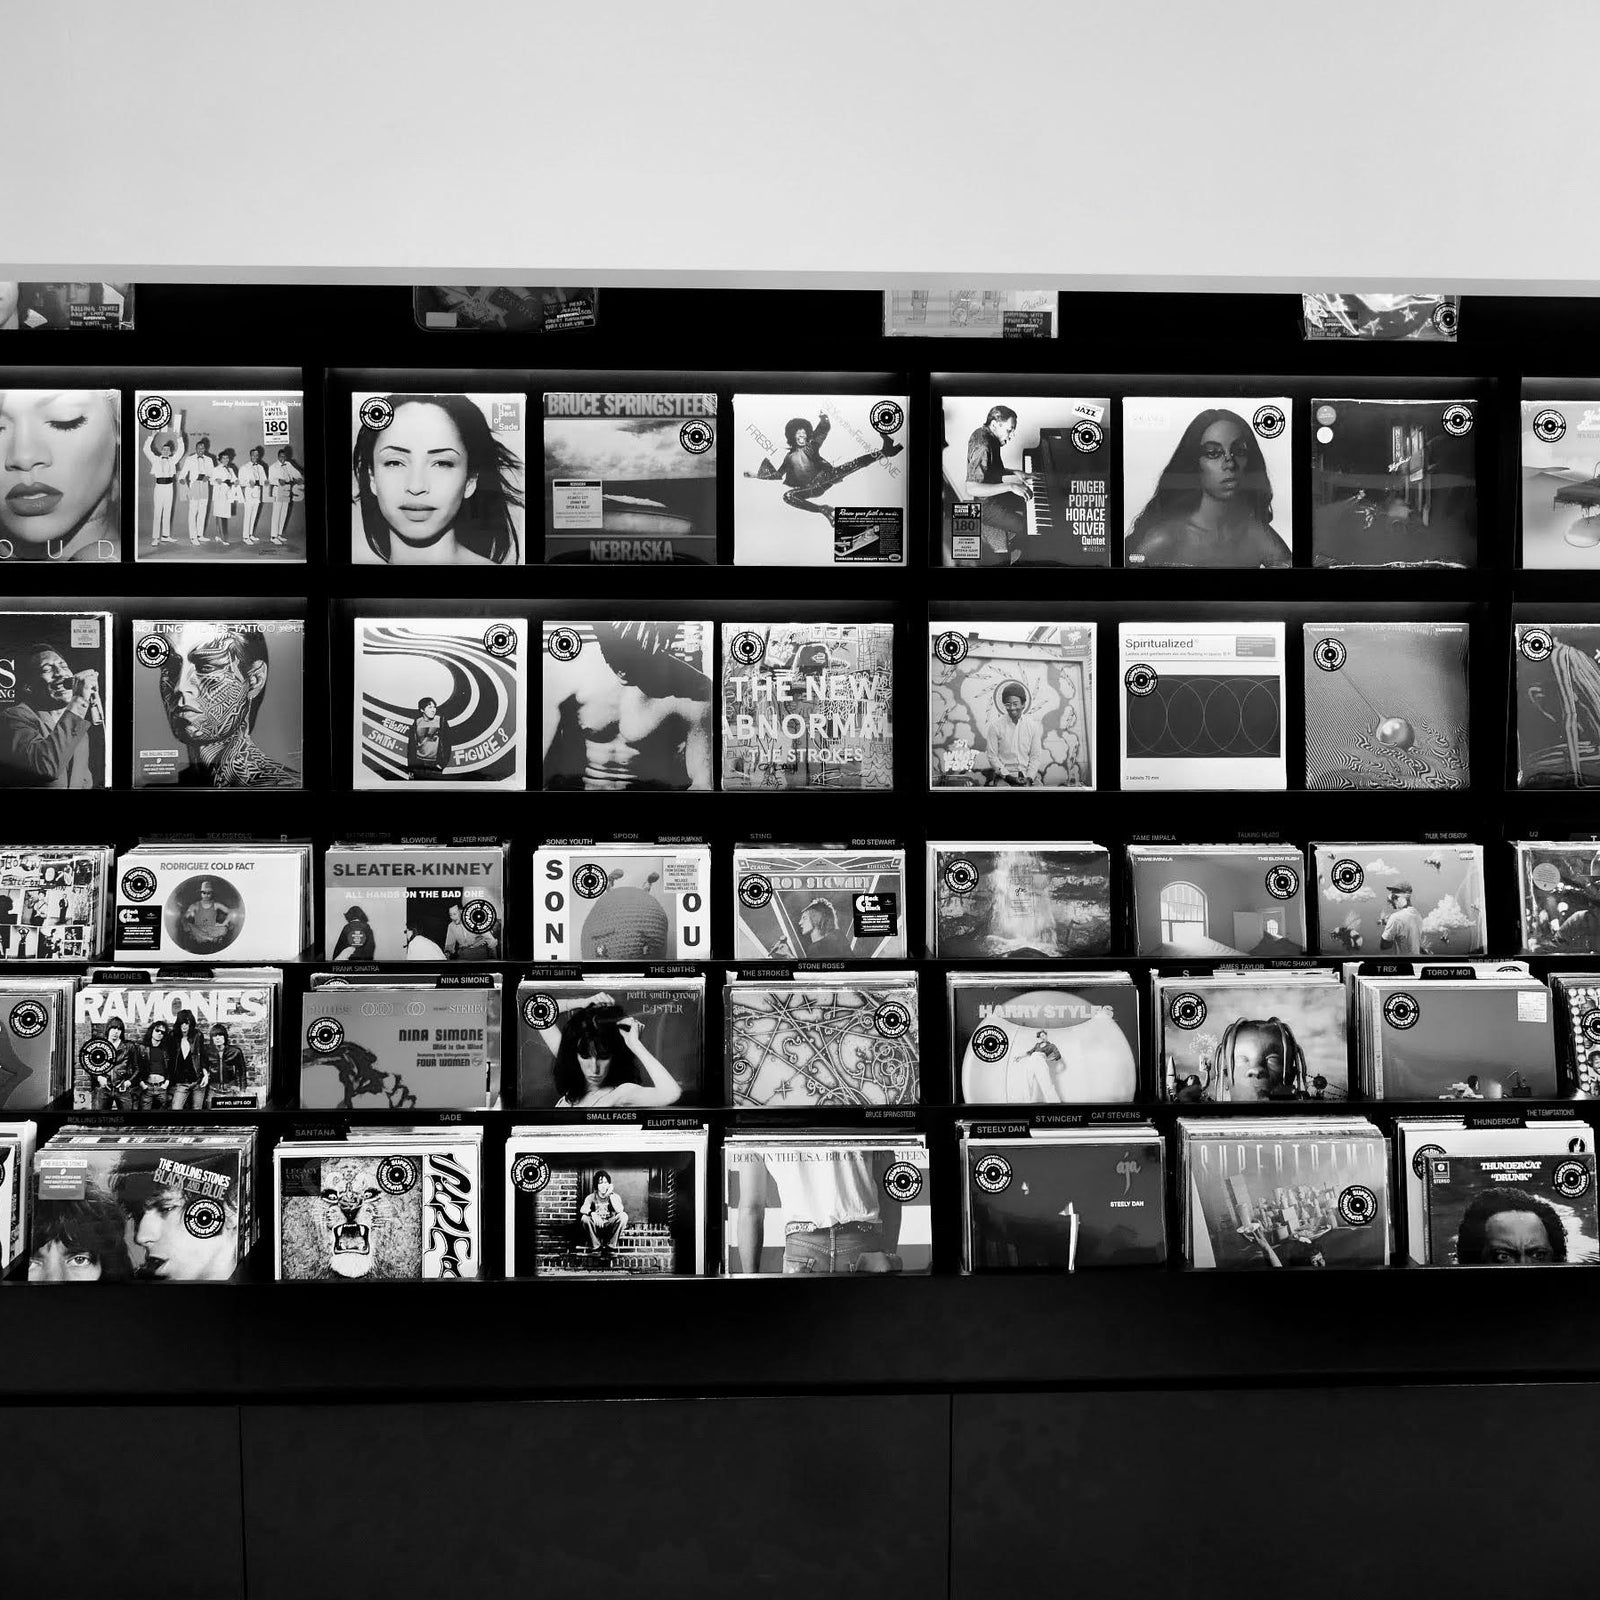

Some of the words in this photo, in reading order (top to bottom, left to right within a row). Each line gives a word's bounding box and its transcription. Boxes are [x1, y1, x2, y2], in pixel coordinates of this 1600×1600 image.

[548, 393, 600, 415] BRUCE
[603, 393, 716, 416] SPRINGSTEEN
[1074, 406, 1097, 418] JAZZ
[264, 420, 288, 432] 180
[498, 423, 519, 431] Sade
[745, 423, 779, 457] FRESH
[1071, 480, 1105, 494] FINGER
[1068, 494, 1108, 508] POPPIN'
[1065, 508, 1106, 522] HORACE
[953, 520, 976, 531] 180
[1072, 522, 1105, 536] SILVER
[1081, 536, 1106, 546] Quintet
[589, 540, 674, 562] NEBRASKA
[1125, 638, 1194, 651] Spiritualized
[730, 676, 794, 702] THE
[806, 675, 881, 701] NEW
[453, 735, 502, 765] FIGURE
[498, 728, 509, 742] 8
[750, 749, 783, 763] THE
[787, 748, 863, 763] STROKES
[658, 835, 680, 843] SMASHING
[681, 835, 703, 843] PUMPKINS
[867, 838, 896, 846] STEWART
[160, 862, 209, 871] RODRIGUEZ
[210, 862, 235, 871] COLD
[235, 862, 255, 871] FACT
[333, 862, 494, 877] SLEATER-KINNEY
[771, 877, 803, 889] ROD
[806, 876, 871, 889] STEWART
[403, 890, 418, 899] ON
[419, 890, 439, 899] THE
[441, 890, 462, 898] BAD
[463, 890, 485, 898] ONE
[544, 859, 565, 960] SON
[757, 969, 790, 977] STROKES
[1182, 969, 1190, 978] S
[1376, 965, 1382, 973] T
[1383, 965, 1398, 973] REX
[1427, 969, 1449, 977] TORO
[102, 972, 143, 980] RAMONES
[460, 976, 490, 984] SIMONE
[626, 991, 648, 1001] patti
[649, 990, 671, 999] smith
[672, 991, 699, 1002] group
[75, 990, 267, 1024] RAMONES
[978, 1004, 1040, 1019] HARRY
[1043, 1004, 1114, 1019] STYLES
[399, 1029, 429, 1042] NINA
[435, 1028, 484, 1041] SIMONE
[416, 1058, 437, 1067] FOUR
[439, 1058, 471, 1067] WOMEN
[439, 1113, 462, 1121] SADE
[612, 1112, 637, 1120] FACES
[882, 1110, 916, 1118] SPRINGSTEEN
[1107, 1111, 1141, 1119] STEVENS
[67, 1116, 97, 1124] ROLLING
[647, 1119, 675, 1127] ELLIOTT
[1472, 1118, 1521, 1126] THUNDERCAT
[295, 1129, 336, 1137] SANTANA
[976, 1126, 1007, 1134] STEELY
[1008, 1125, 1026, 1133] DAN
[733, 1152, 762, 1163] BORN
[763, 1152, 774, 1162] IN
[776, 1151, 798, 1162] THE
[1480, 1160, 1542, 1170] THUNDERCAT
[159, 1157, 174, 1171] THE
[173, 1160, 202, 1179] ROLLING
[200, 1170, 231, 1188] STONES
[153, 1168, 186, 1190] BLACK
[186, 1181, 201, 1192] AND
[201, 1182, 228, 1201] BLUE
[1110, 1200, 1130, 1208] STEELY
